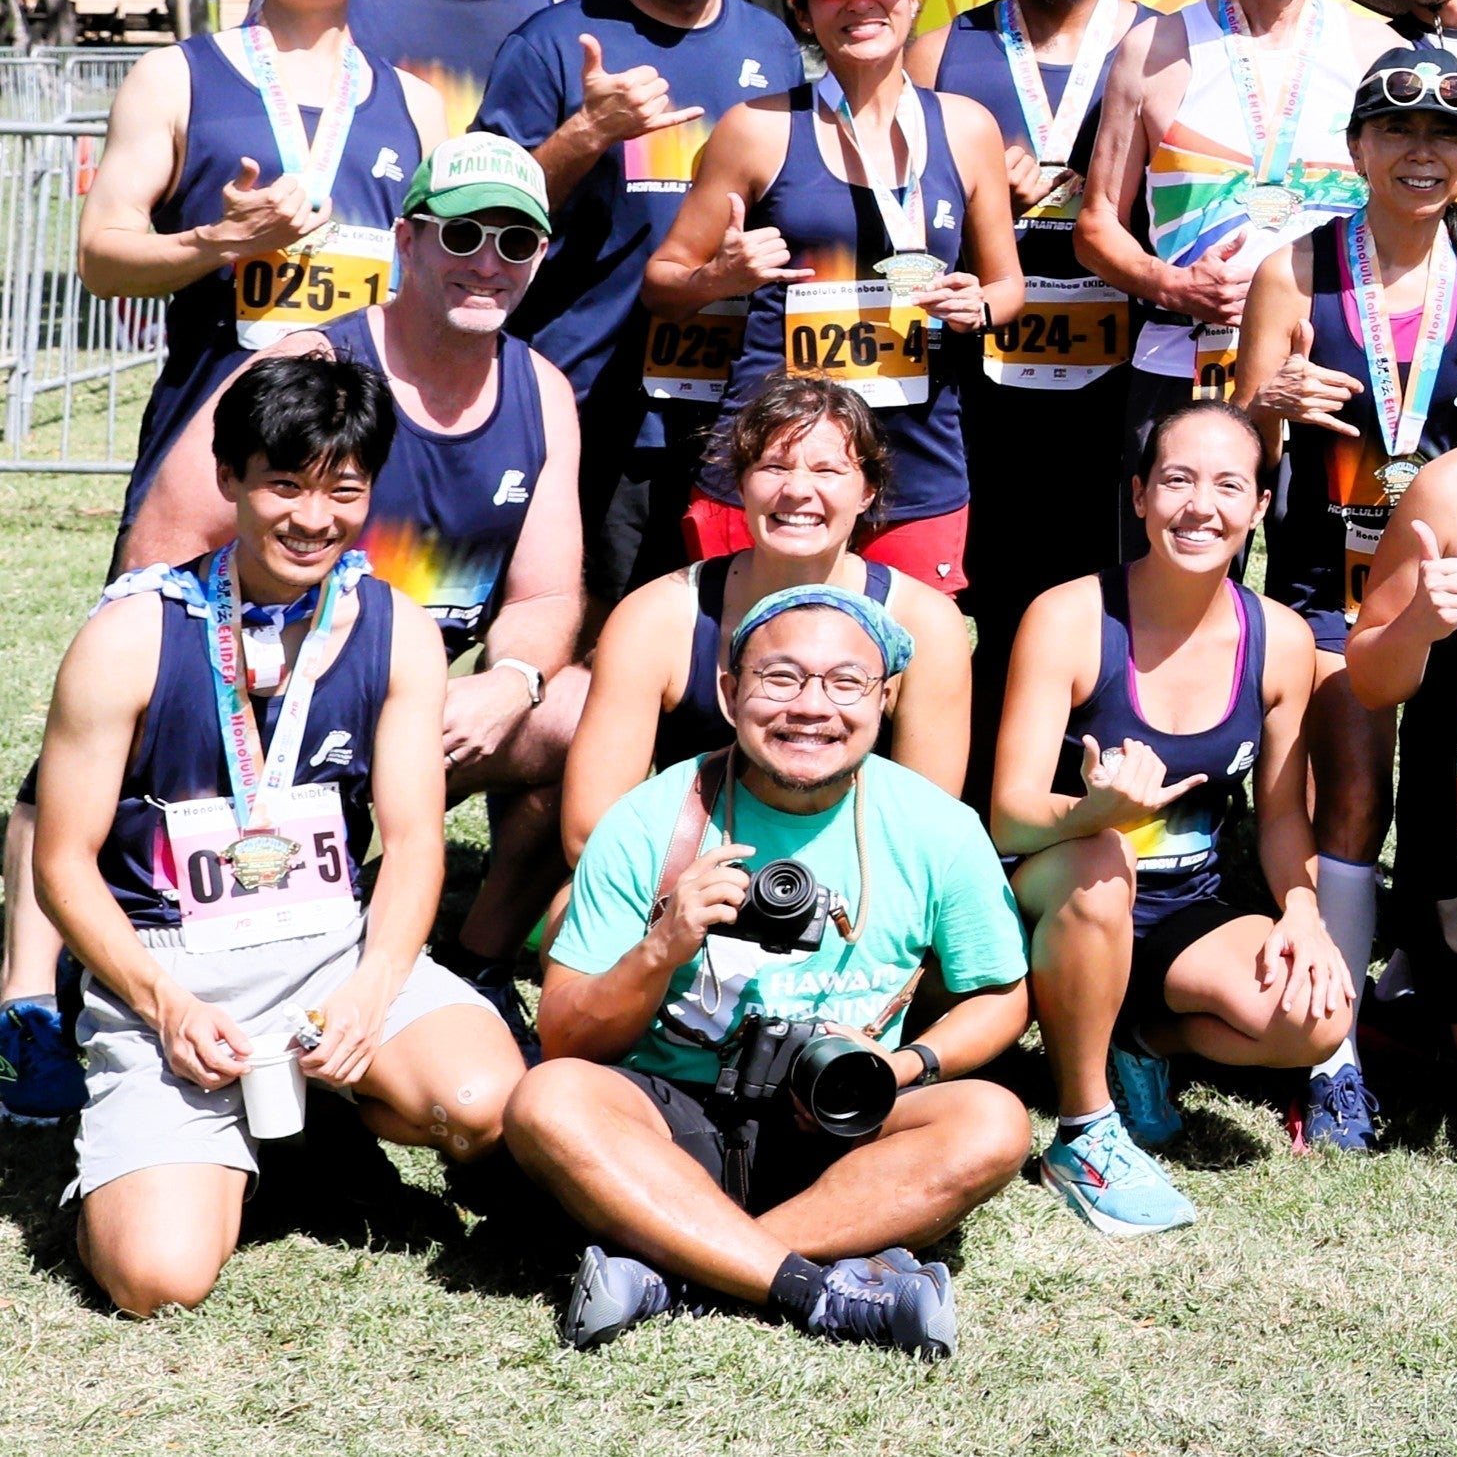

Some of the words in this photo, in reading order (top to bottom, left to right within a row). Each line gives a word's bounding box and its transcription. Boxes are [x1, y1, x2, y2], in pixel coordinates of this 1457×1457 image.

[242, 259, 380, 312] 025-1
[1355, 224, 1374, 285] Honolulu
[1365, 291, 1385, 357] Rainbow
[792, 319, 923, 371] 026-4
[995, 313, 1117, 355] 024-1
[217, 624, 237, 685] EKIDEN
[231, 714, 256, 787] Honolulu
[188, 831, 342, 904] 0-5
